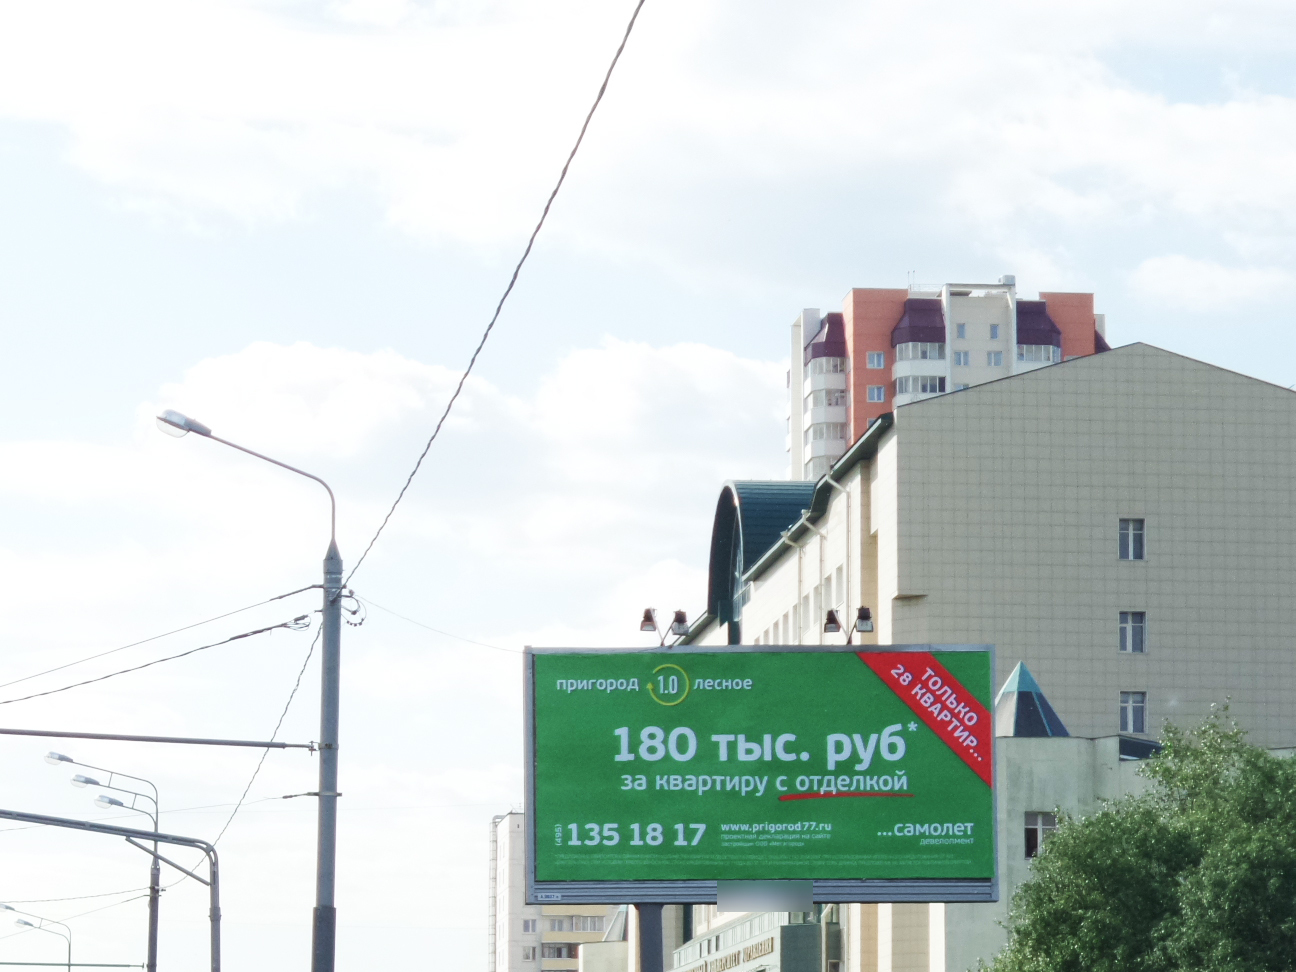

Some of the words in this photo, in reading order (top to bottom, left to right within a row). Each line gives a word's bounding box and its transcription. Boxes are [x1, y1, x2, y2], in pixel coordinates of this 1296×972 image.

[556, 677, 639, 694] пригород
[657, 675, 679, 694] 1.0
[693, 678, 754, 690] лесное
[921, 667, 979, 726] ТОЛЬКО
[890, 664, 913, 686] 28
[910, 684, 983, 762] КВАРТИР...
[613, 725, 698, 762] 180
[710, 732, 811, 762] тыс.
[620, 774, 647, 791] за
[655, 774, 769, 797] квартиру
[775, 775, 788, 791] с
[795, 769, 909, 795] отделкой
[554, 823, 563, 846] (495)
[567, 822, 621, 846] 135
[629, 822, 664, 846] 18
[673, 823, 707, 846] 17
[721, 821, 832, 833] www.prigorod77.ru
